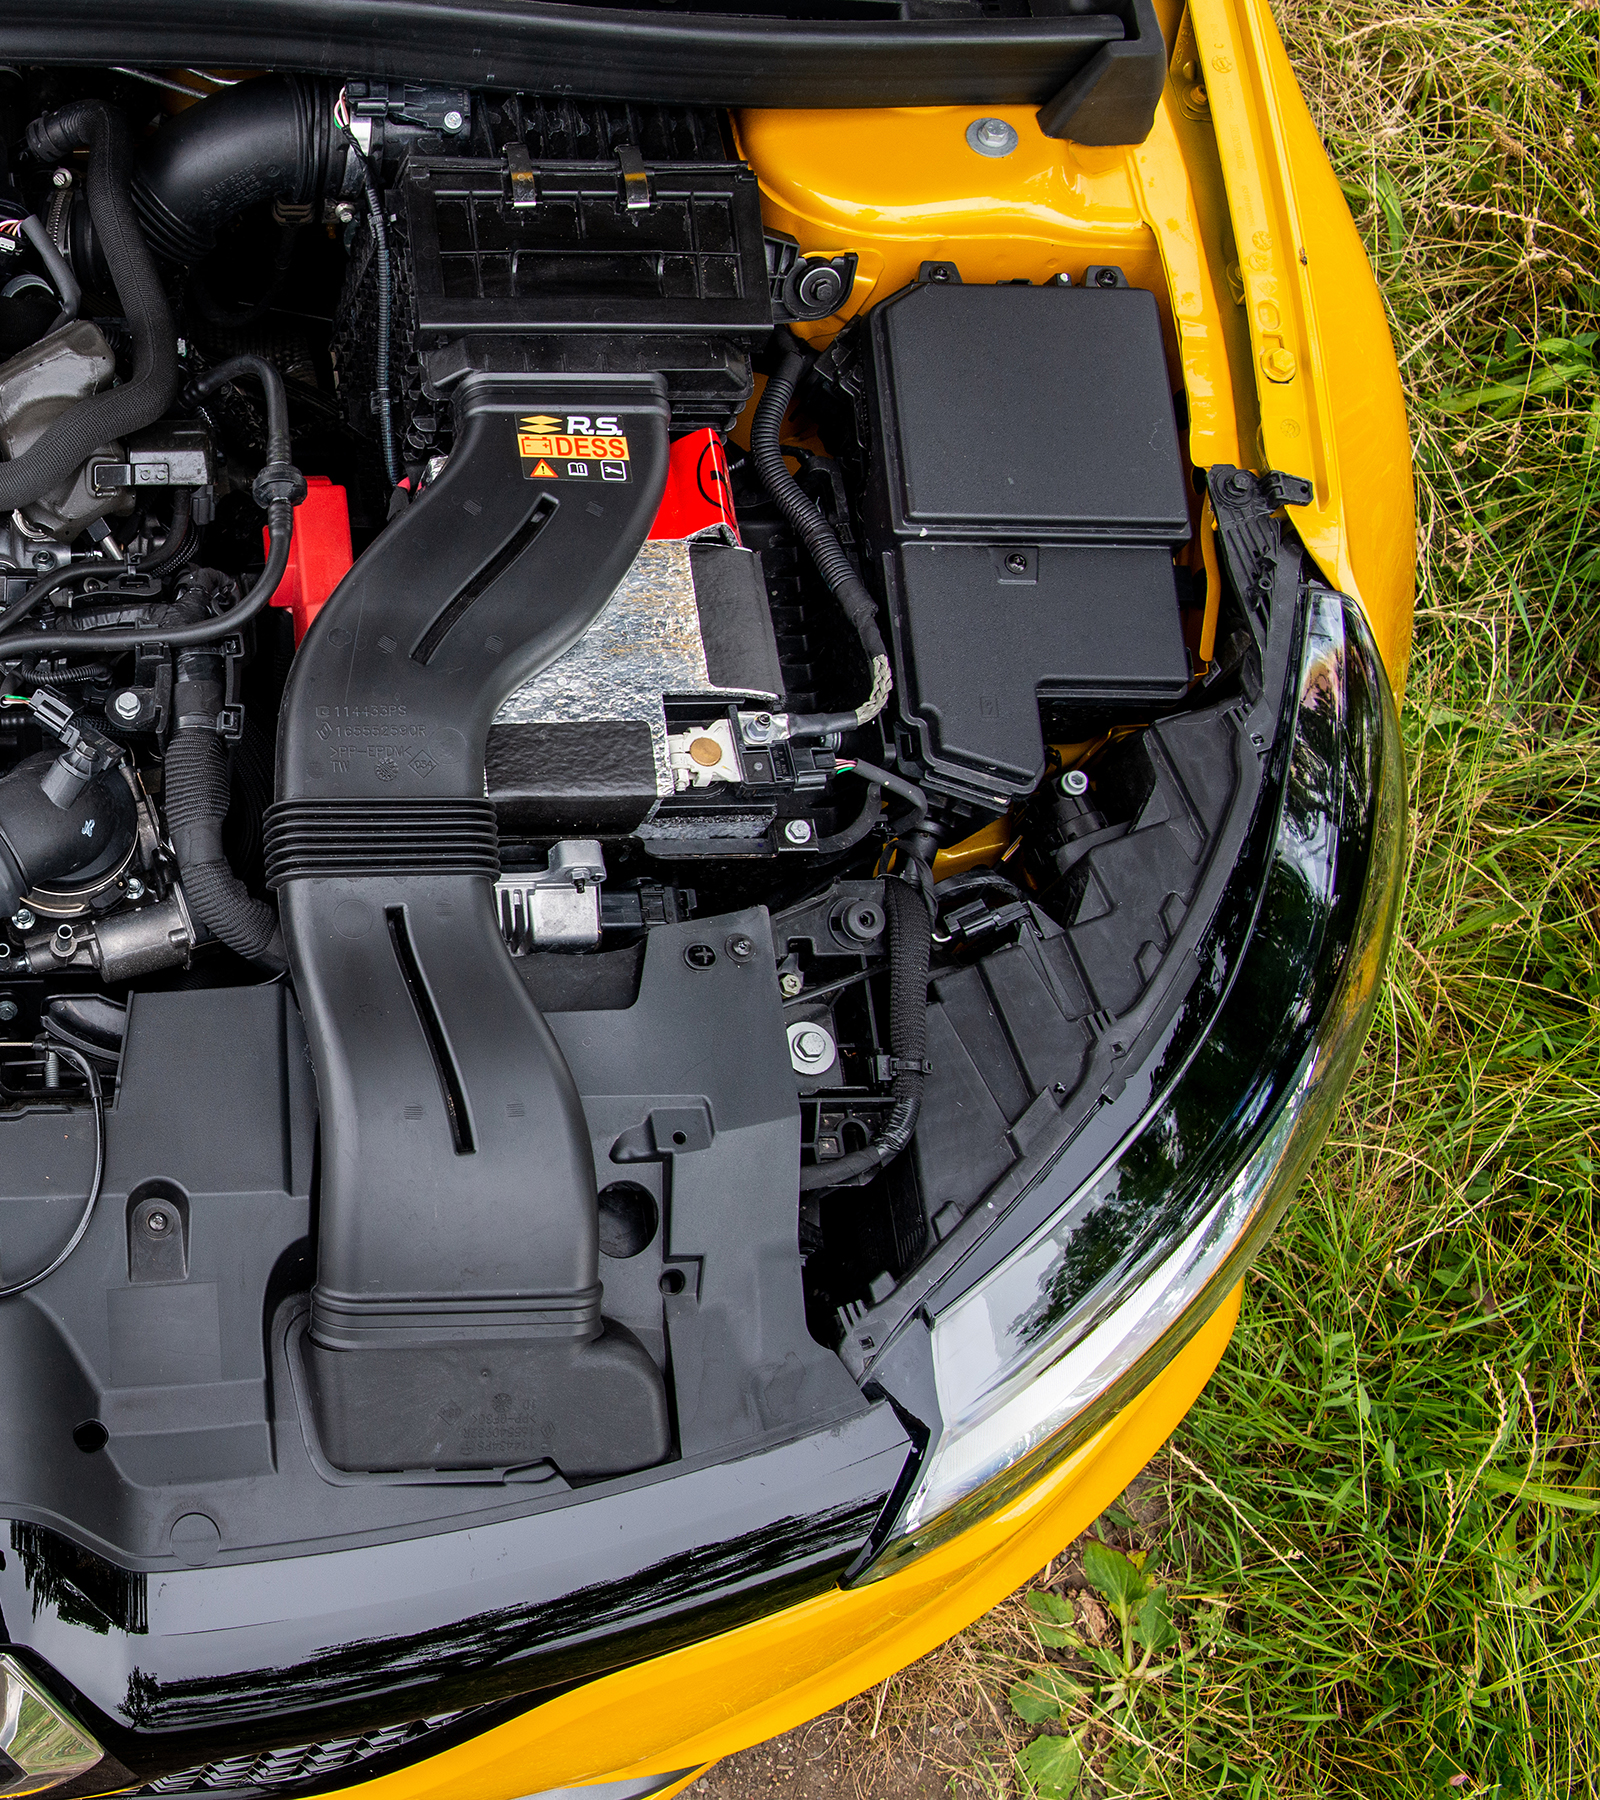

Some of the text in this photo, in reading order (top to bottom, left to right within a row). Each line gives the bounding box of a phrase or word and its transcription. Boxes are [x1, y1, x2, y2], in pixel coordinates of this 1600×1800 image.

[566, 415, 623, 436] R.S.
[555, 436, 626, 459] DESS
[334, 705, 407, 717] 114433PS
[335, 725, 427, 738] 165552590R
